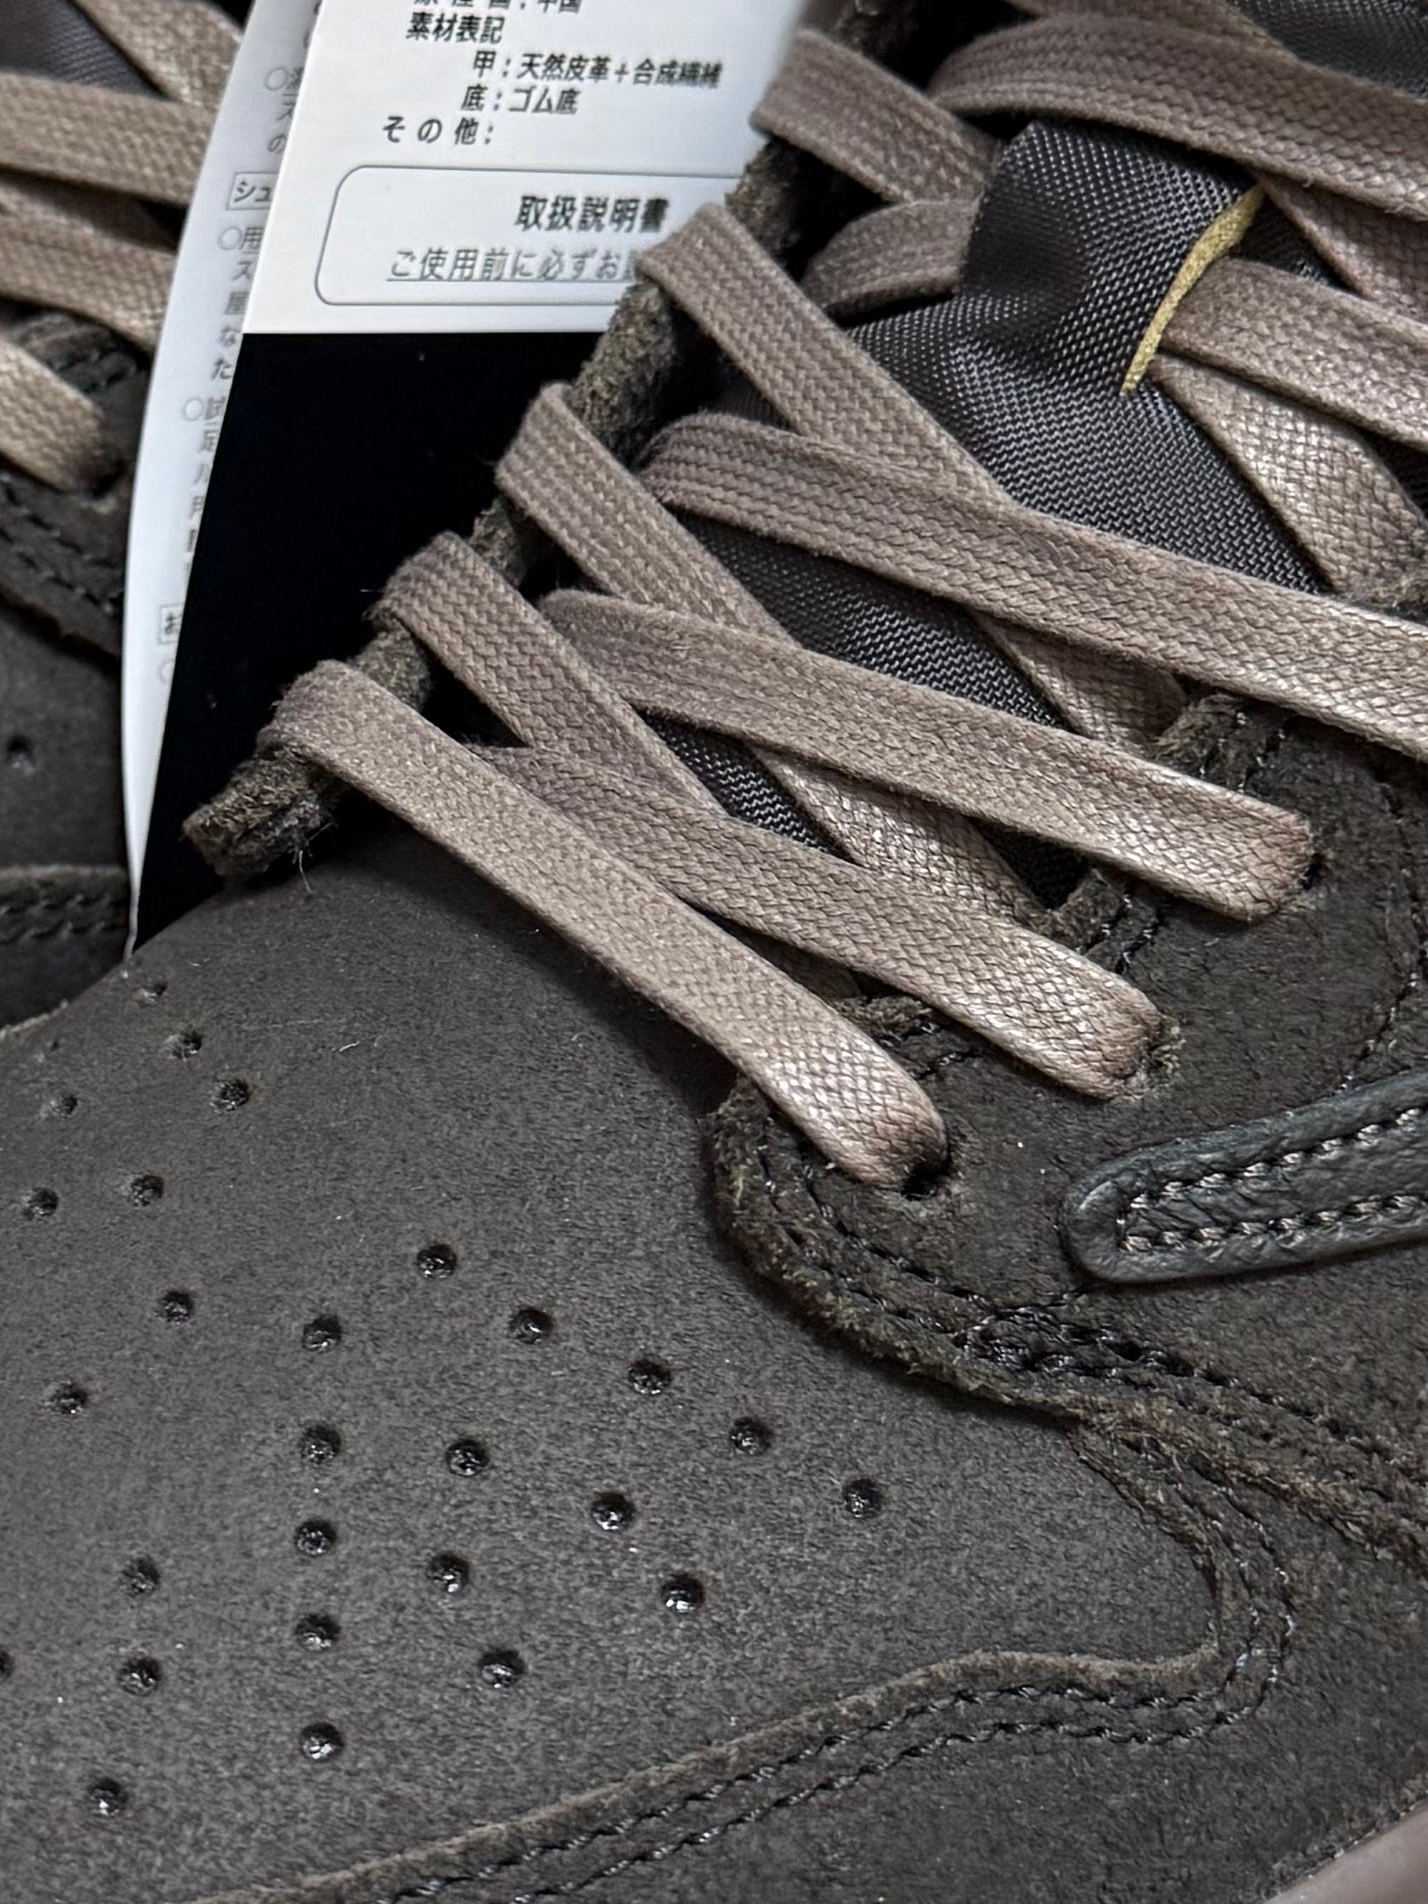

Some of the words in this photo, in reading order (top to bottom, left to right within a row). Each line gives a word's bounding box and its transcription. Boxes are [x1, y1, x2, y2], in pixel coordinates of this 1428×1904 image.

[405, 11, 506, 45] 素材表記
[514, 194, 670, 233] 取扱説明書
